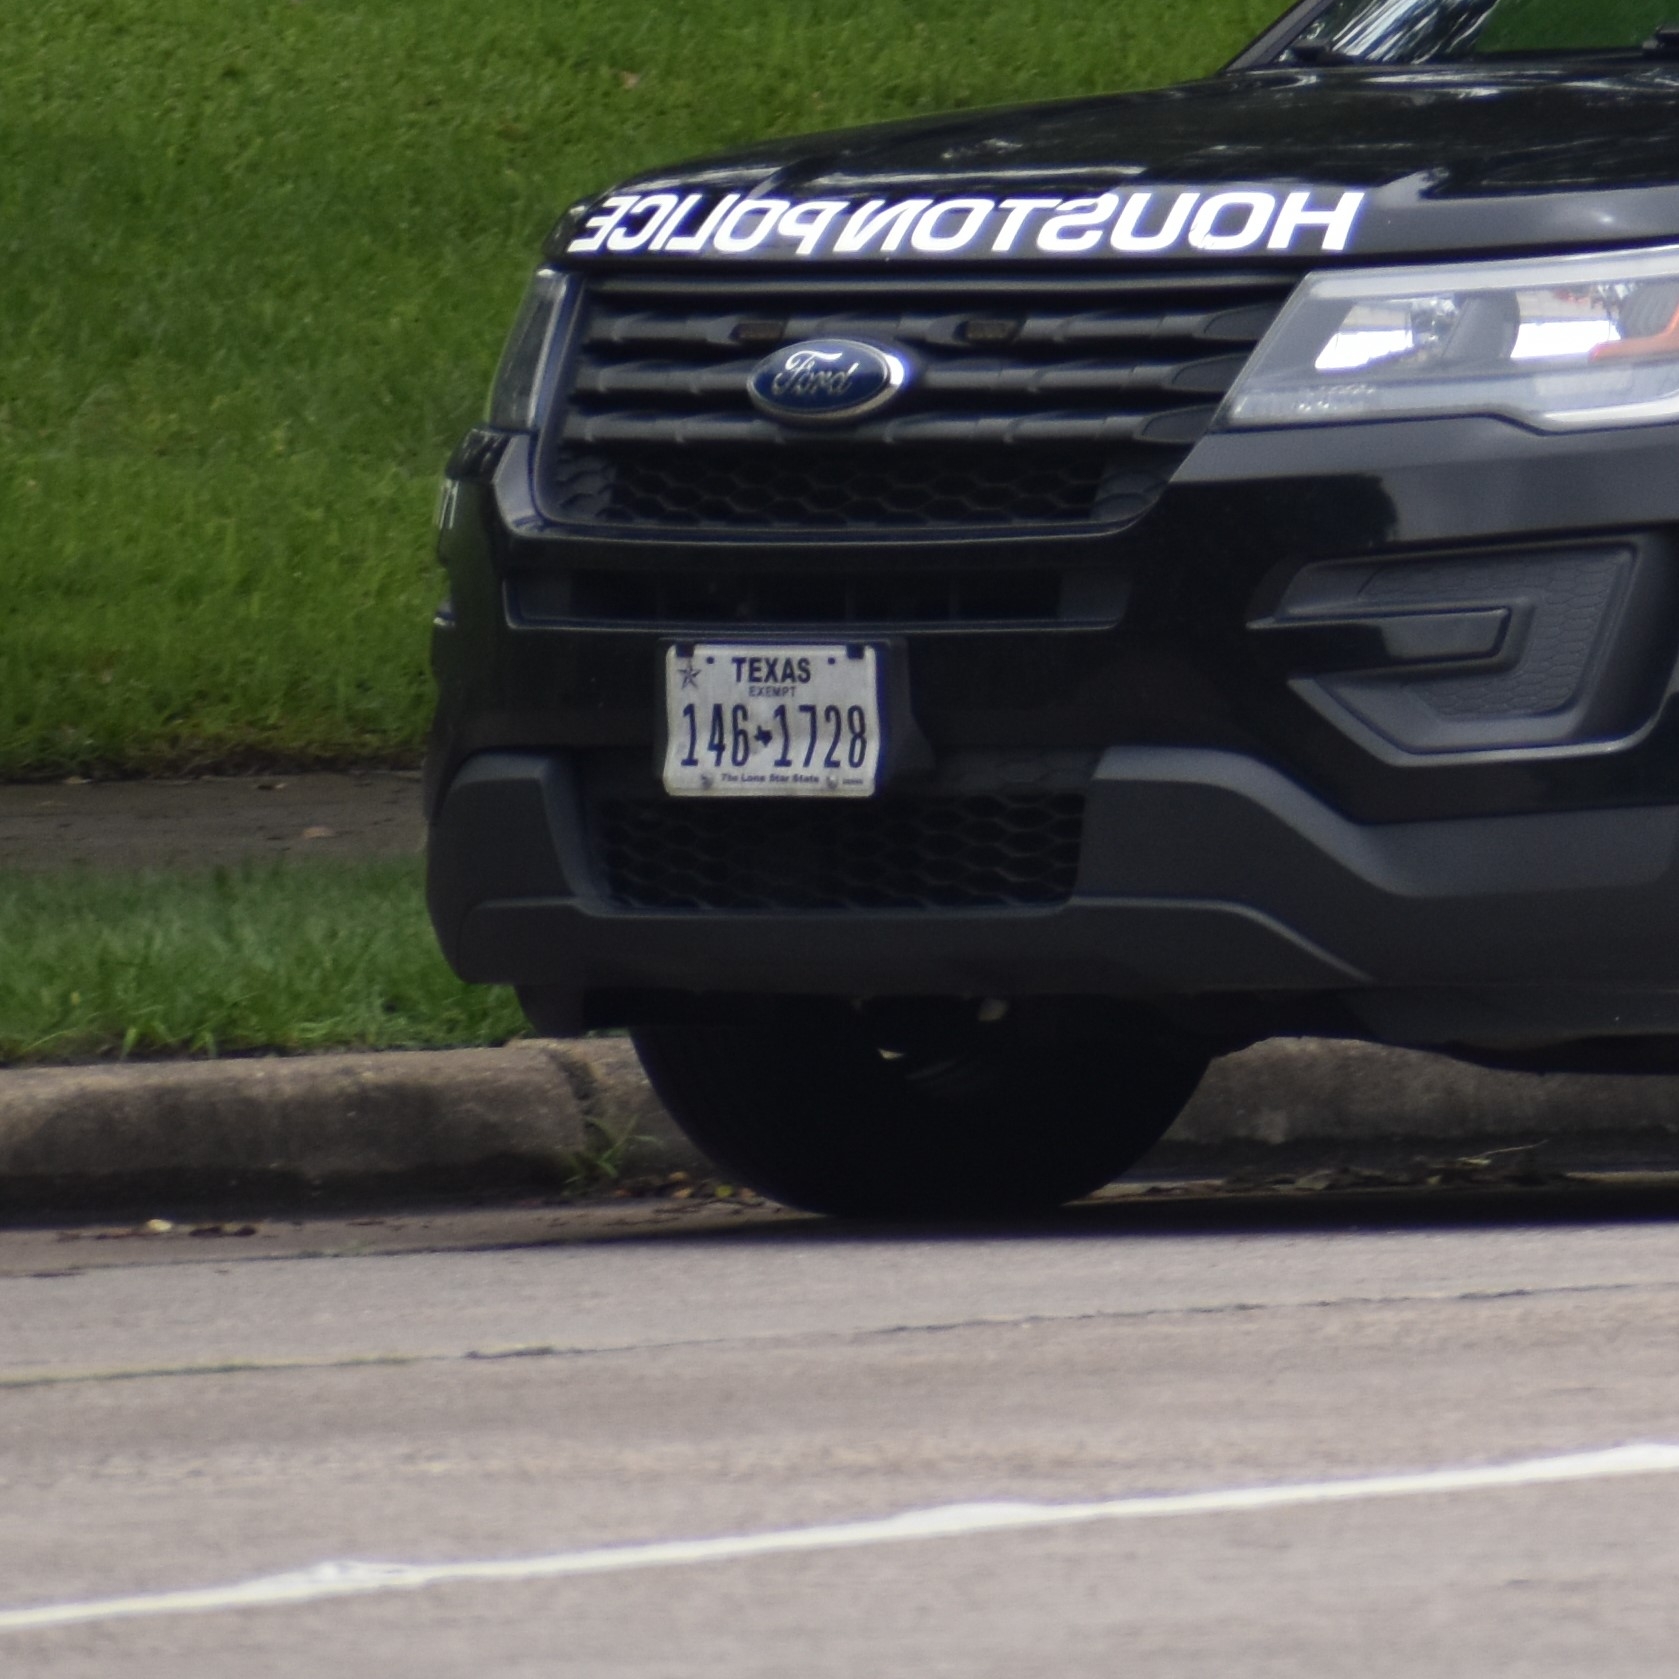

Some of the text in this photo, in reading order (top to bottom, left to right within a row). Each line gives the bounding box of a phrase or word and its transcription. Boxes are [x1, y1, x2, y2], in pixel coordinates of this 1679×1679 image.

[771, 350, 859, 396] Ford
[731, 656, 812, 684] TEXAS
[748, 685, 797, 698] EXEMPT
[741, 773, 766, 784] Lone
[769, 773, 790, 784] Star
[792, 773, 820, 784] State
